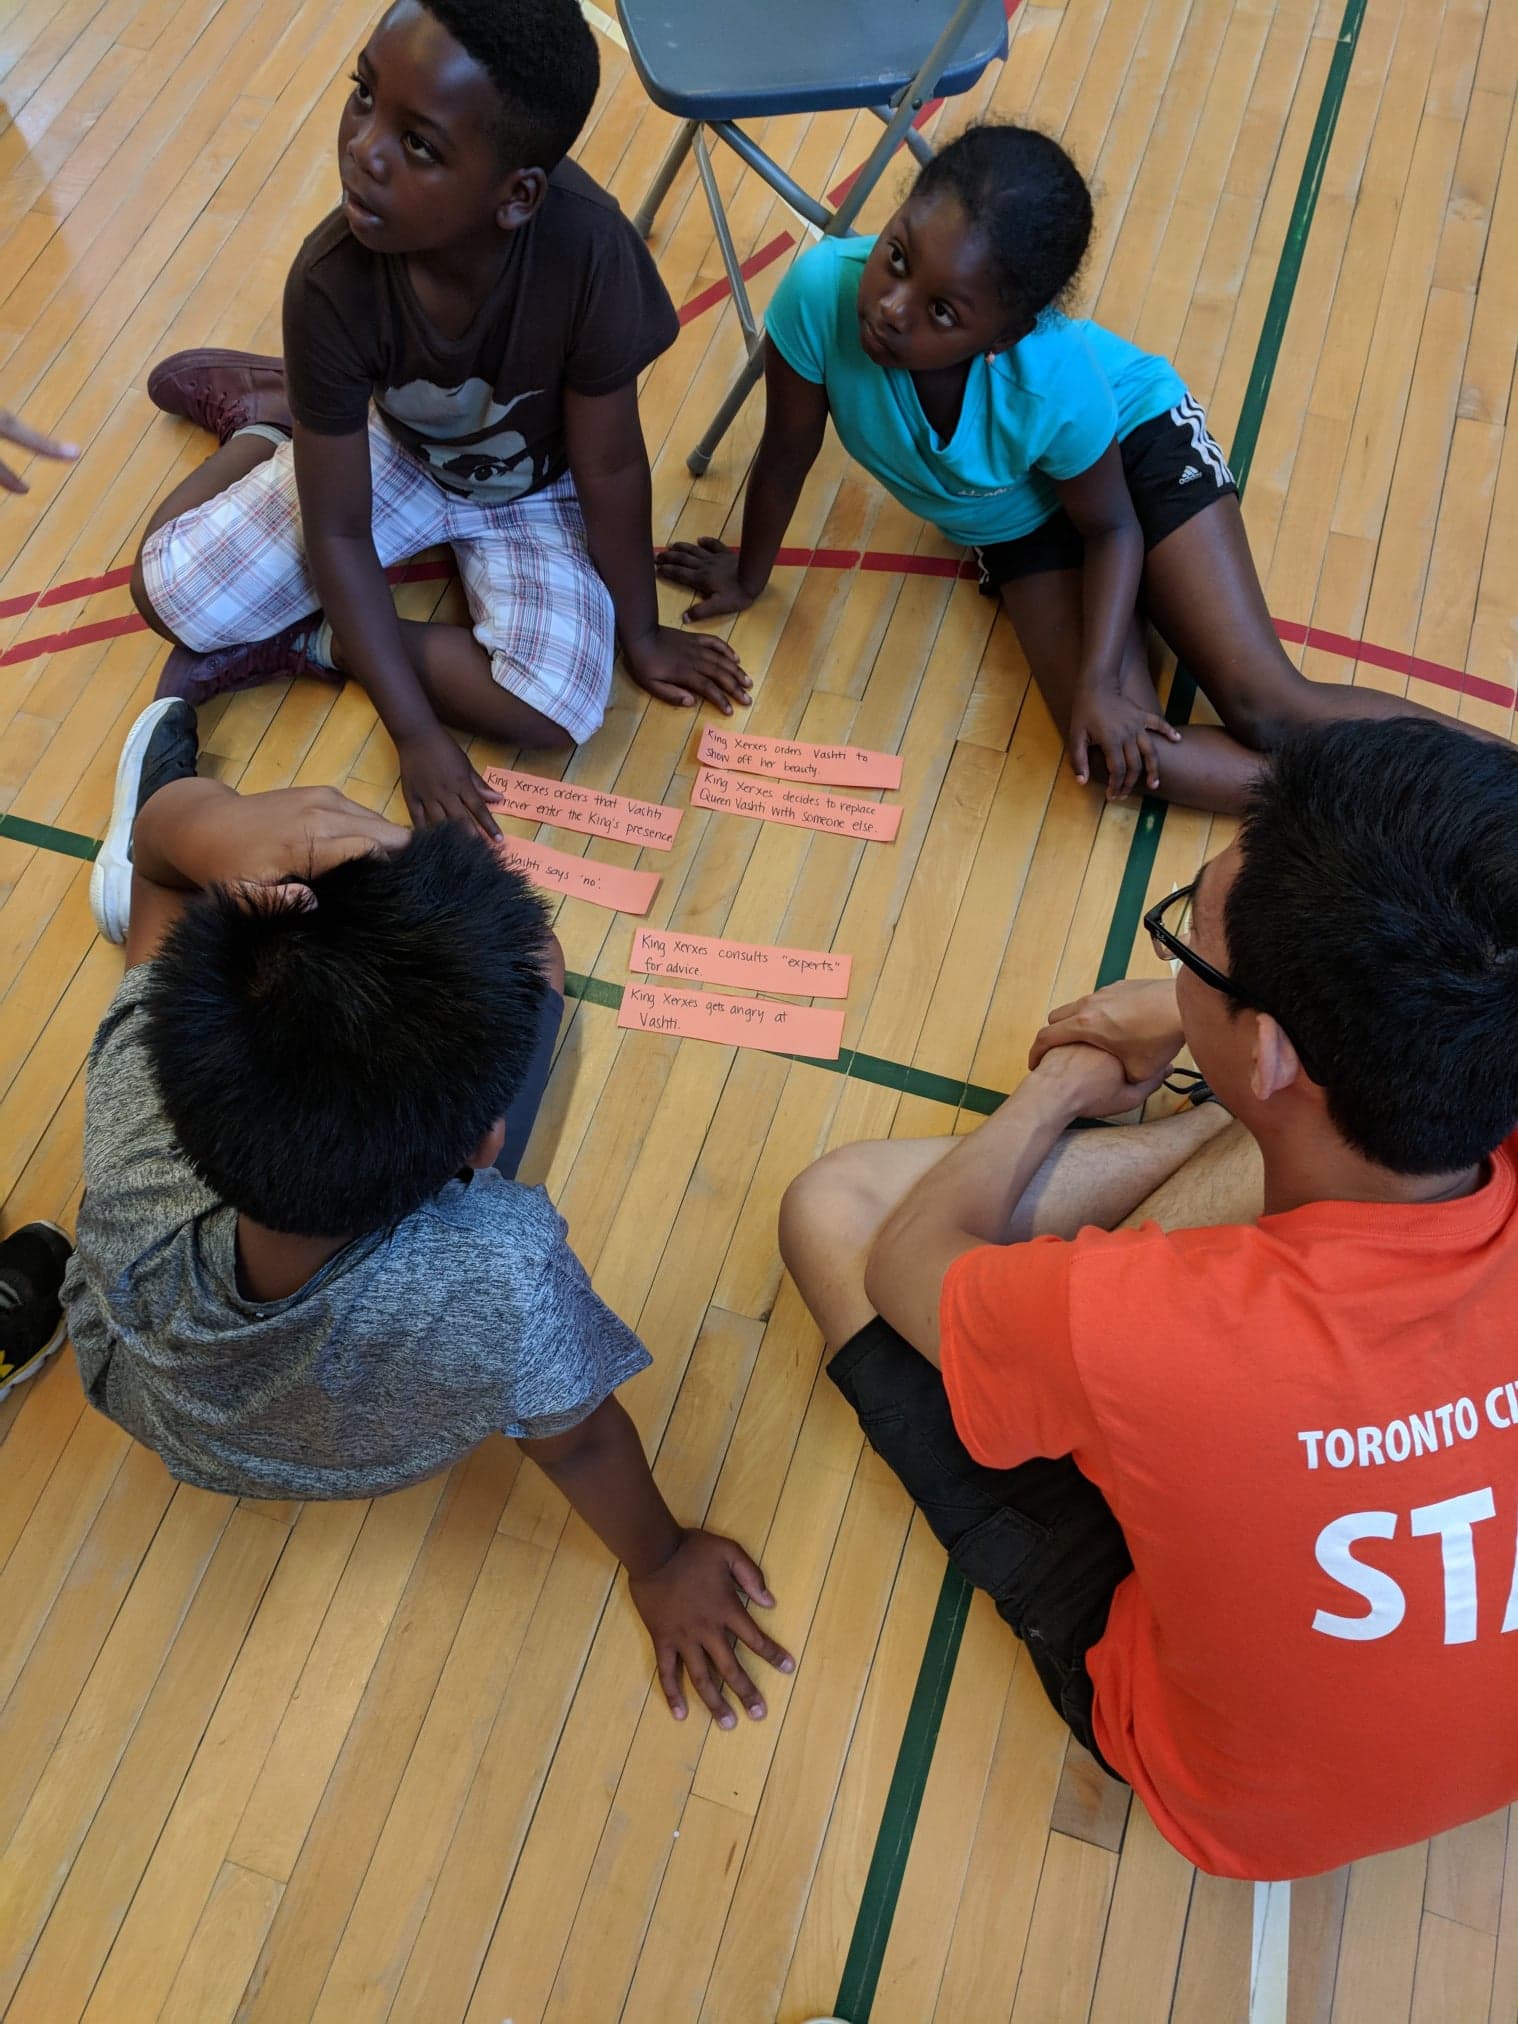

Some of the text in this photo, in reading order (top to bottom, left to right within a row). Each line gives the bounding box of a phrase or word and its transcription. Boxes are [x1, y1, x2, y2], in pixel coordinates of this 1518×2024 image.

[707, 729, 868, 762] King Xerxes orders Vashti to
[737, 754, 753, 765] off
[760, 757, 776, 769] her
[487, 772, 665, 820] King Xerxes orders that Vashti
[699, 787, 731, 807] Queen
[735, 798, 765, 814] Vashti
[771, 805, 796, 820] with
[704, 771, 876, 815] King Xerxes decides to replace
[502, 798, 531, 812] never
[536, 803, 561, 817] enter
[568, 809, 582, 821] the
[588, 811, 619, 830] King's
[510, 853, 540, 871] Vashti
[545, 865, 570, 881] says
[641, 934, 666, 957] King
[673, 939, 708, 956] Xerxes
[718, 948, 768, 963] consults
[644, 956, 661, 972] for
[631, 988, 788, 1023] King Xerxes gets angry at
[1297, 1379, 1518, 1470] TORONTO CI
[1311, 1486, 1518, 1646] ST
